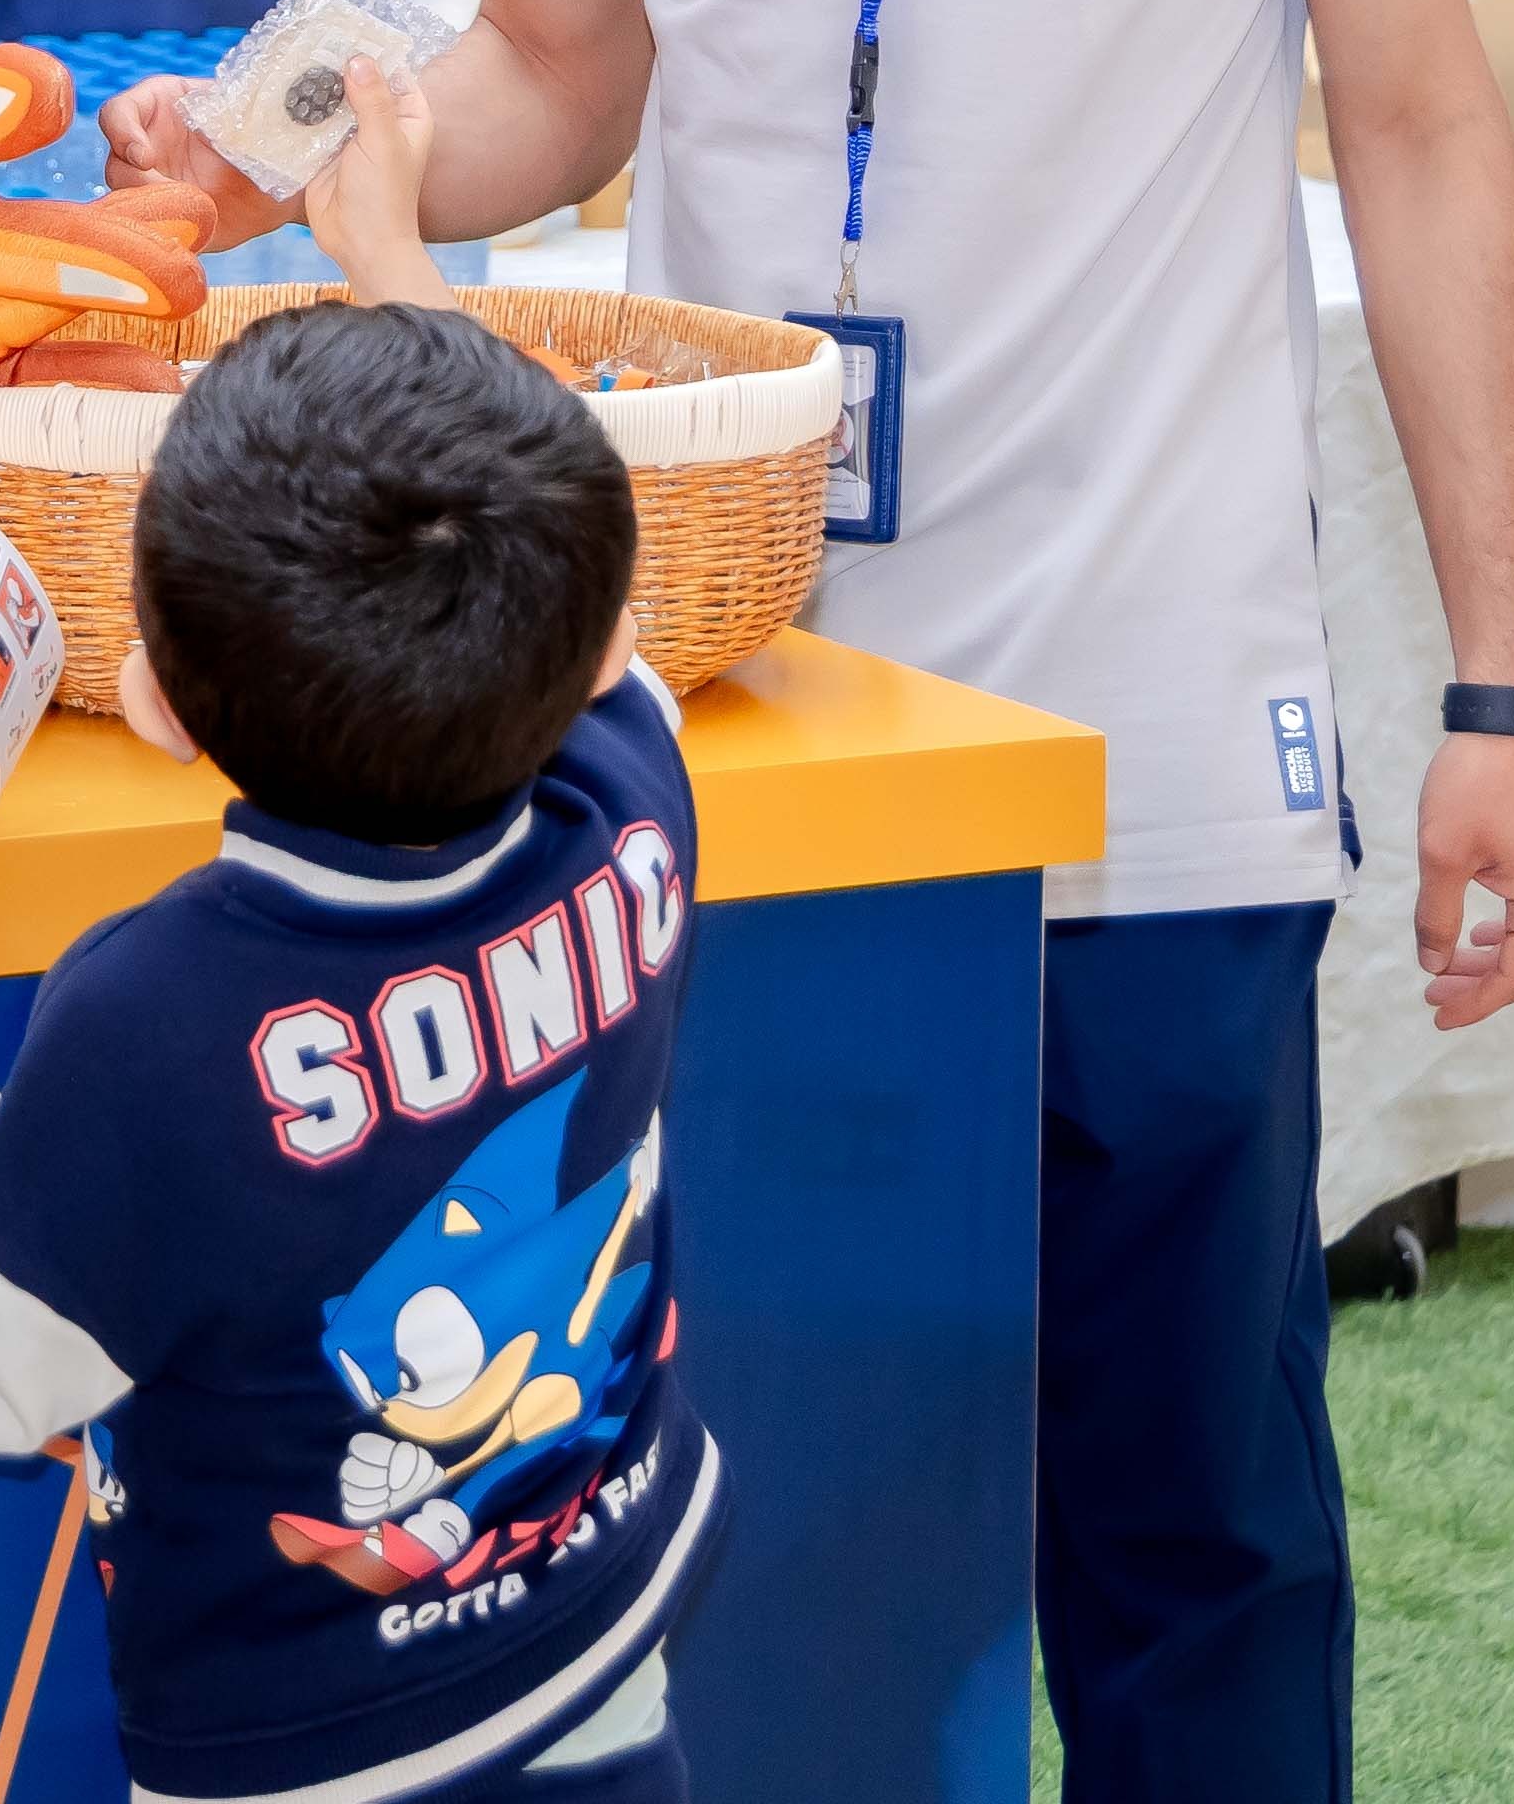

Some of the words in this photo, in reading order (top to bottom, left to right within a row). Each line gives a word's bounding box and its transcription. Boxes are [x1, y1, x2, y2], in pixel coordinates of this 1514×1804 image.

[1294, 747, 1309, 793] LICENSED
[1301, 747, 1316, 793] PRODUCT
[249, 819, 685, 1166] SONIC
[378, 1573, 528, 1642] GOTTA
